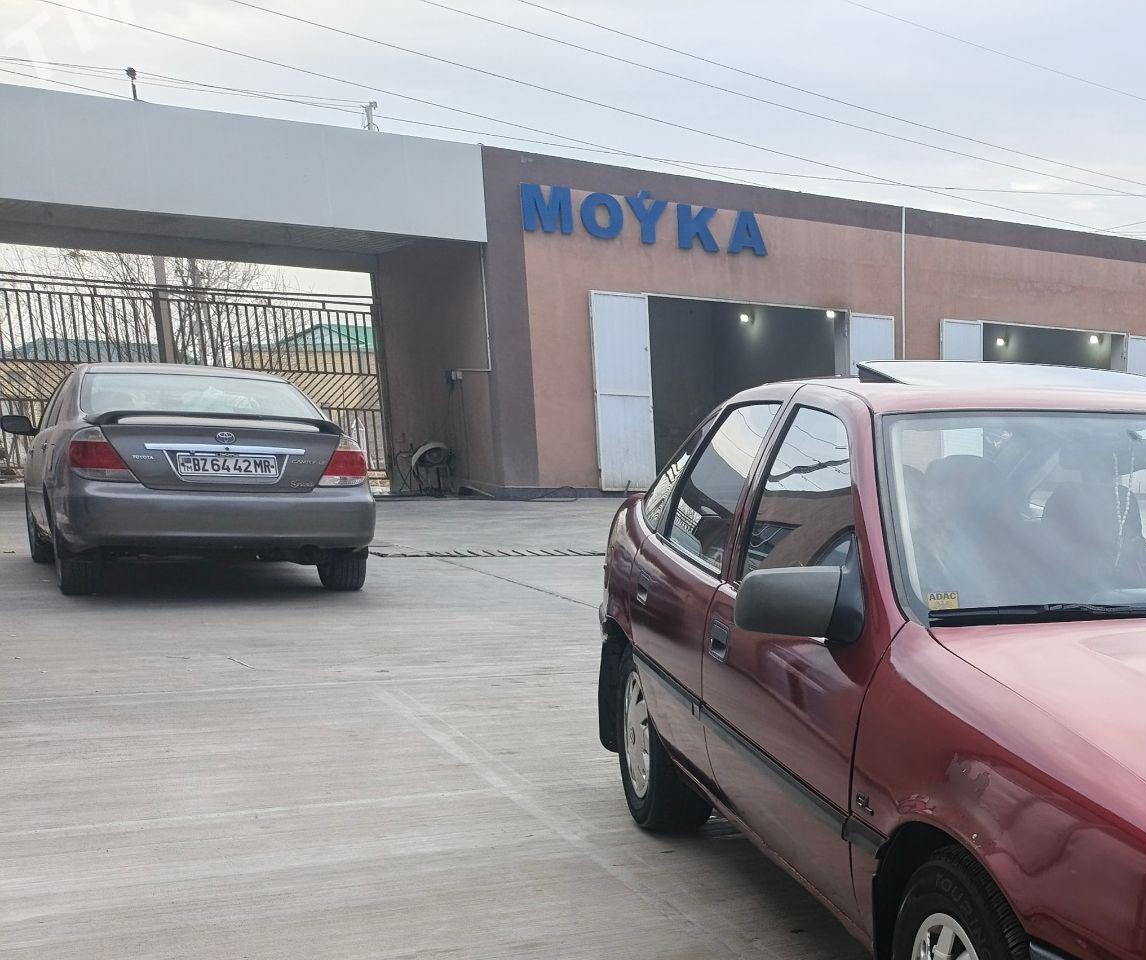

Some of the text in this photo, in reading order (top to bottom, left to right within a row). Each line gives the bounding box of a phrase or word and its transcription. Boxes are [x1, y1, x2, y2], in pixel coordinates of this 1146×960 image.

[519, 182, 769, 257] MOÝKA
[192, 457, 209, 472] BZ
[254, 459, 272, 474] MR
[929, 592, 957, 601] ADAC
